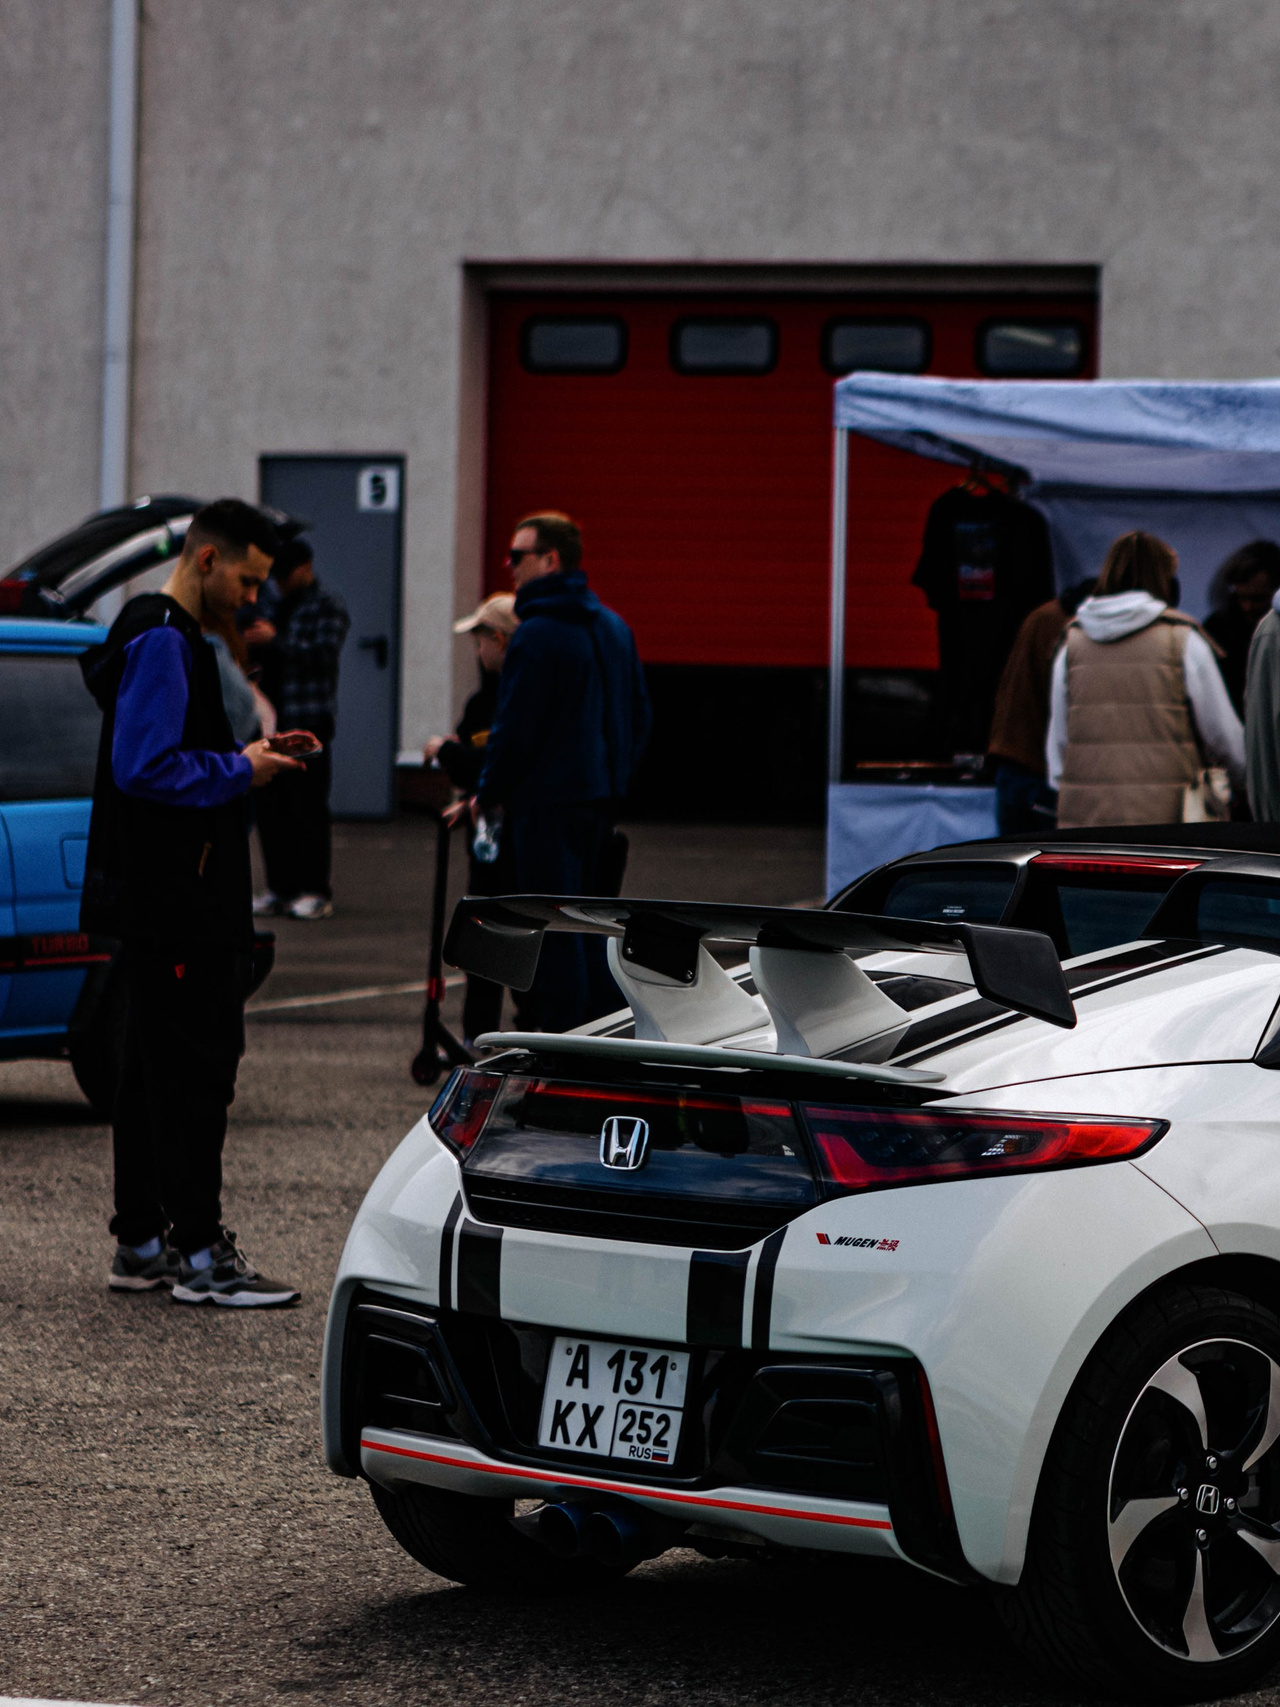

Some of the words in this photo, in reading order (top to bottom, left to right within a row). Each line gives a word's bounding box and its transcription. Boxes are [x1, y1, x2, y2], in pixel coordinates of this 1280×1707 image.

[32, 933, 90, 954] TURBO
[834, 1236, 879, 1249] MUGEN
[566, 1344, 590, 1389] A
[607, 1349, 669, 1400] 131
[549, 1399, 605, 1449] KX
[618, 1408, 671, 1448] 252
[628, 1445, 651, 1460] RUS
